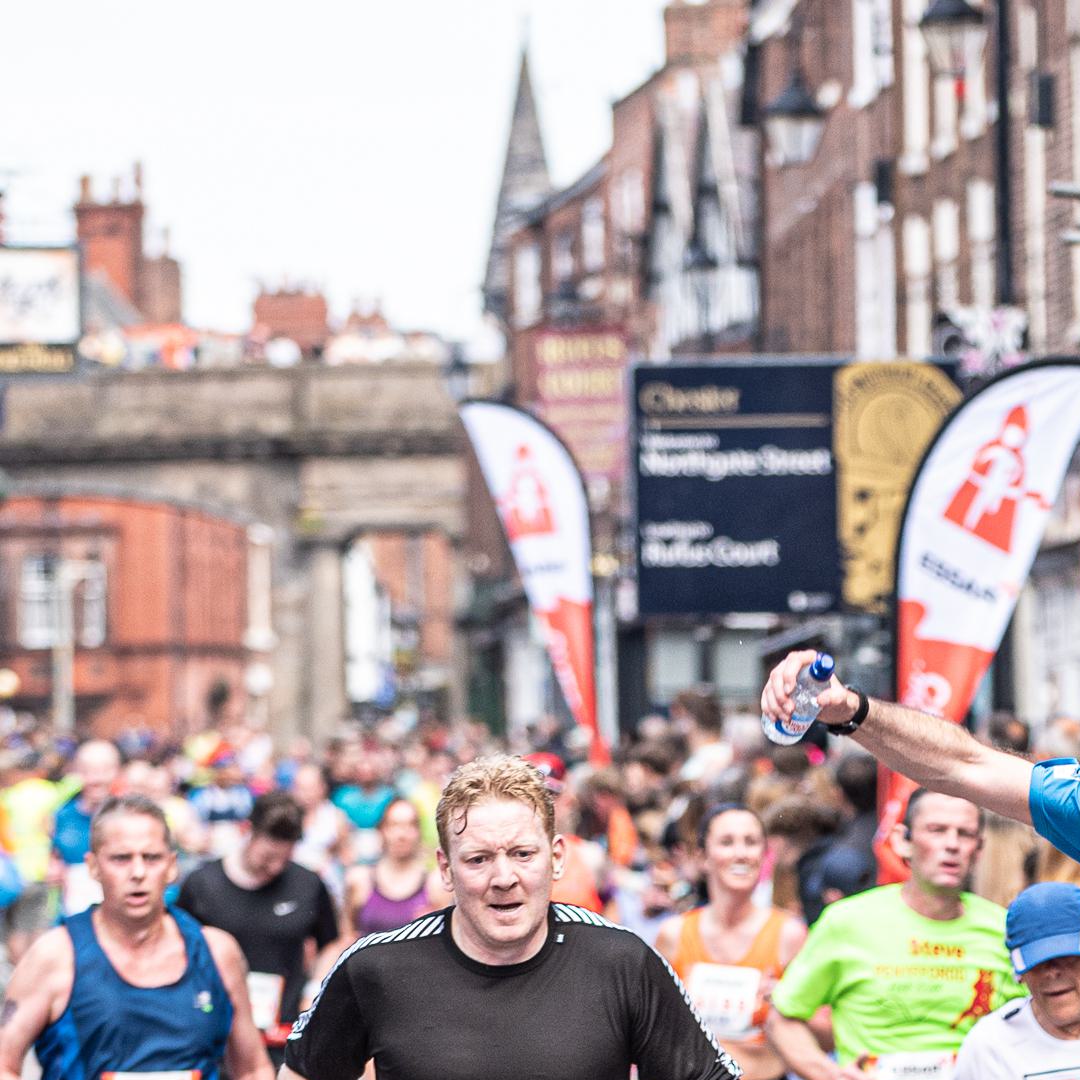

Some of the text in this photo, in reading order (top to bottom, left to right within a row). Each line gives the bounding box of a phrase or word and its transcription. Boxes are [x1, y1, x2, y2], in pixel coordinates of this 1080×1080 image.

[640, 382, 740, 414] Chester
[640, 445, 832, 481] Northgate Street
[920, 552, 998, 604] ESSAR
[911, 937, 963, 958] Steve
